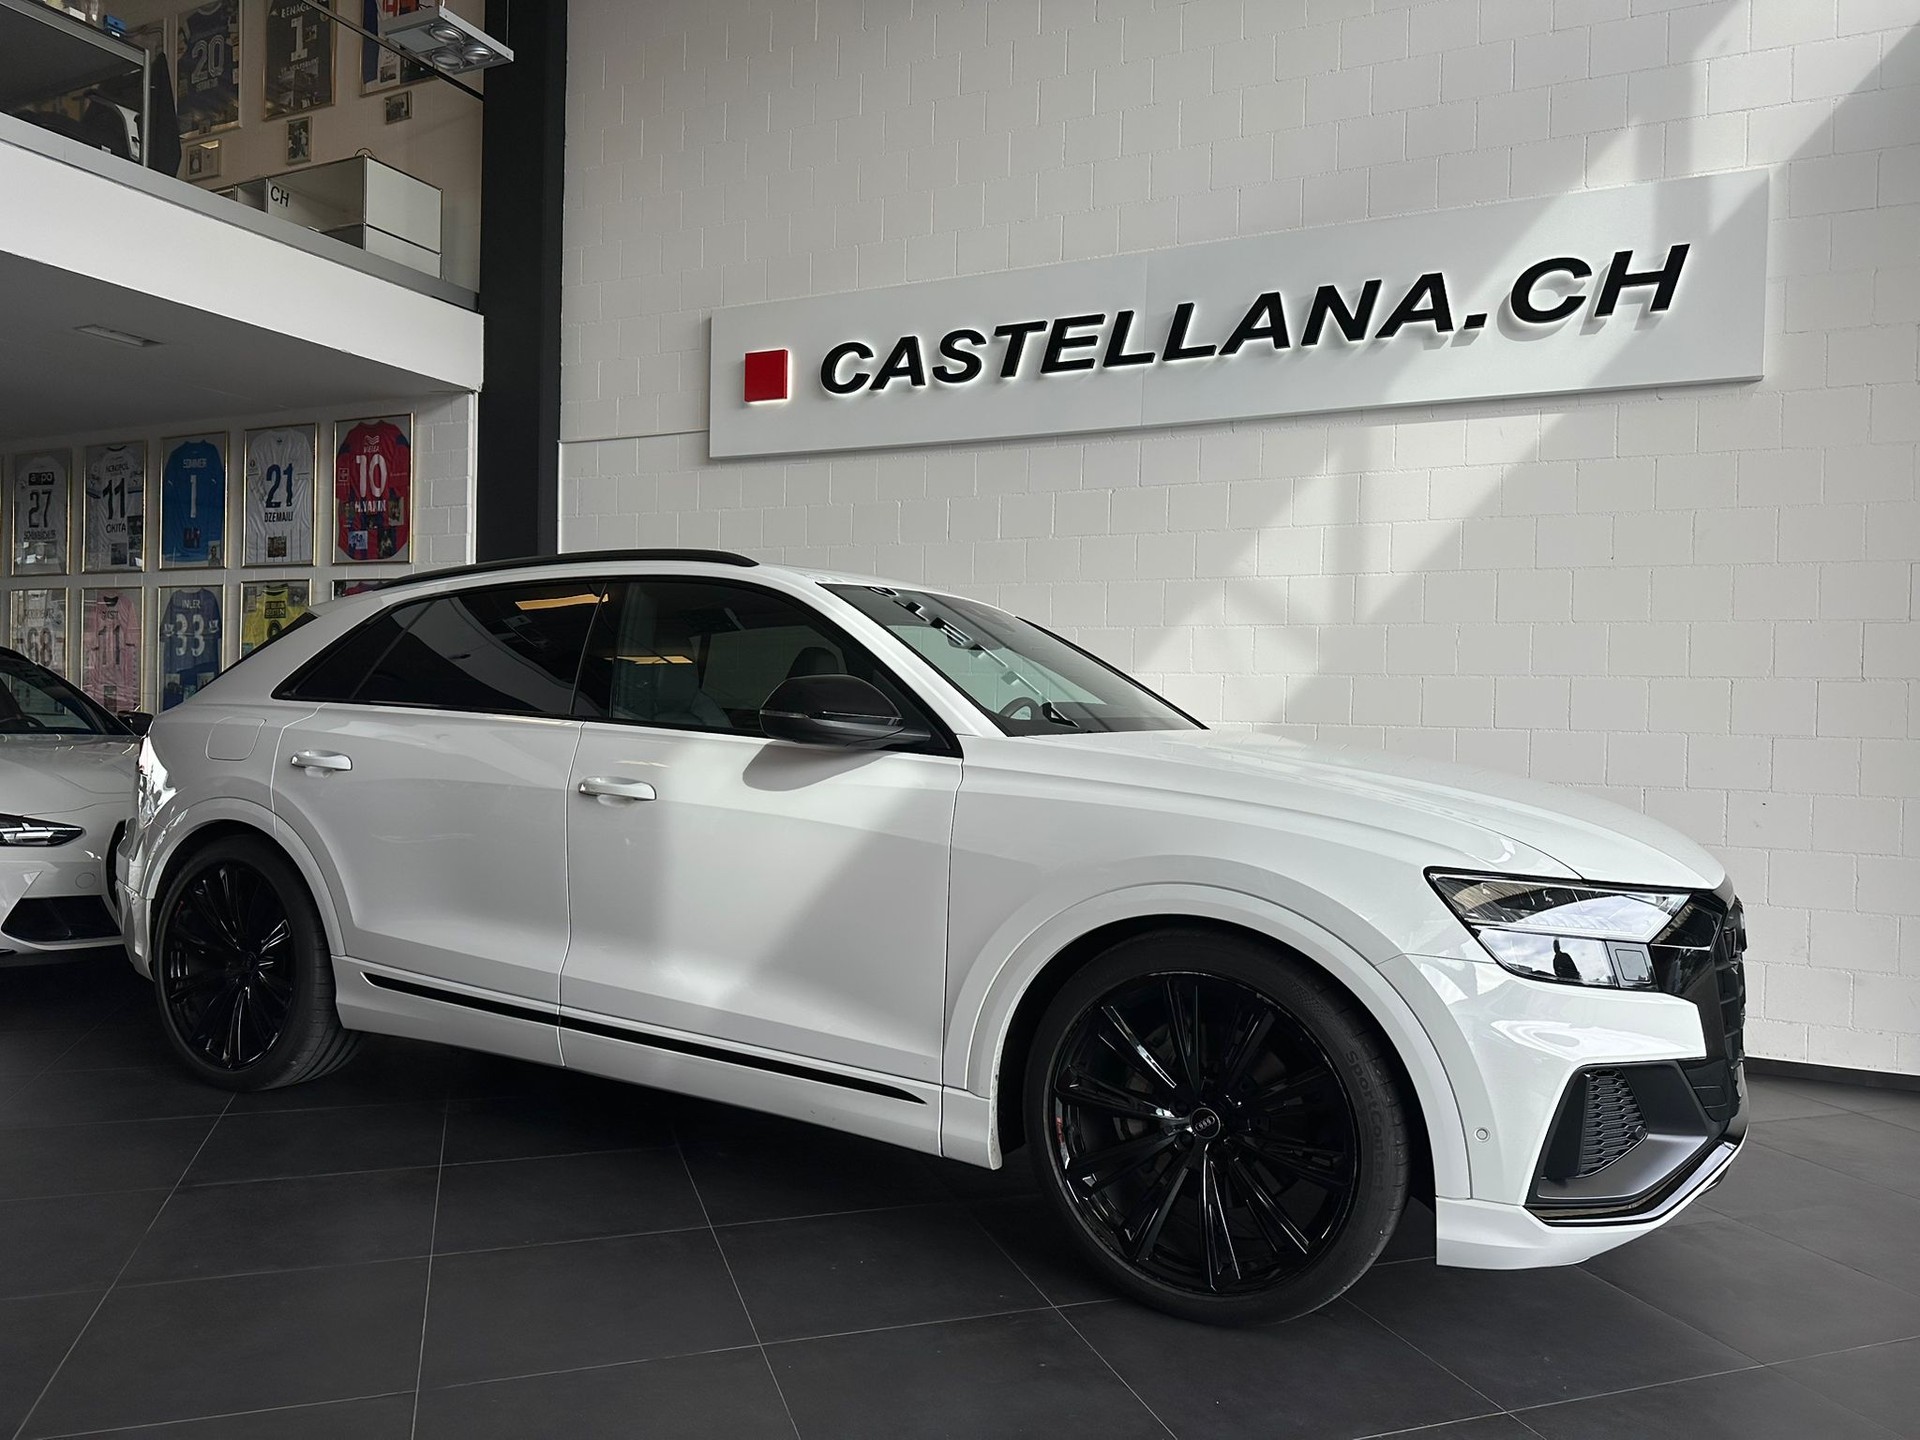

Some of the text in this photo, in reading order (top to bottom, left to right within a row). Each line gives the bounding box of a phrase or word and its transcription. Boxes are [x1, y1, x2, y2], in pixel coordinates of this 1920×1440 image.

[281, 2, 313, 18] BENAGL
[191, 34, 225, 85] 20
[291, 15, 308, 62] 1
[271, 186, 290, 207] CH
[820, 243, 1691, 395] CASTELLANA.CH
[190, 474, 197, 518] 1
[266, 463, 293, 508] 21
[356, 453, 388, 498] 10
[28, 490, 52, 528] 27
[103, 477, 125, 520] 11
[98, 625, 120, 665] 11
[176, 612, 205, 657] 33
